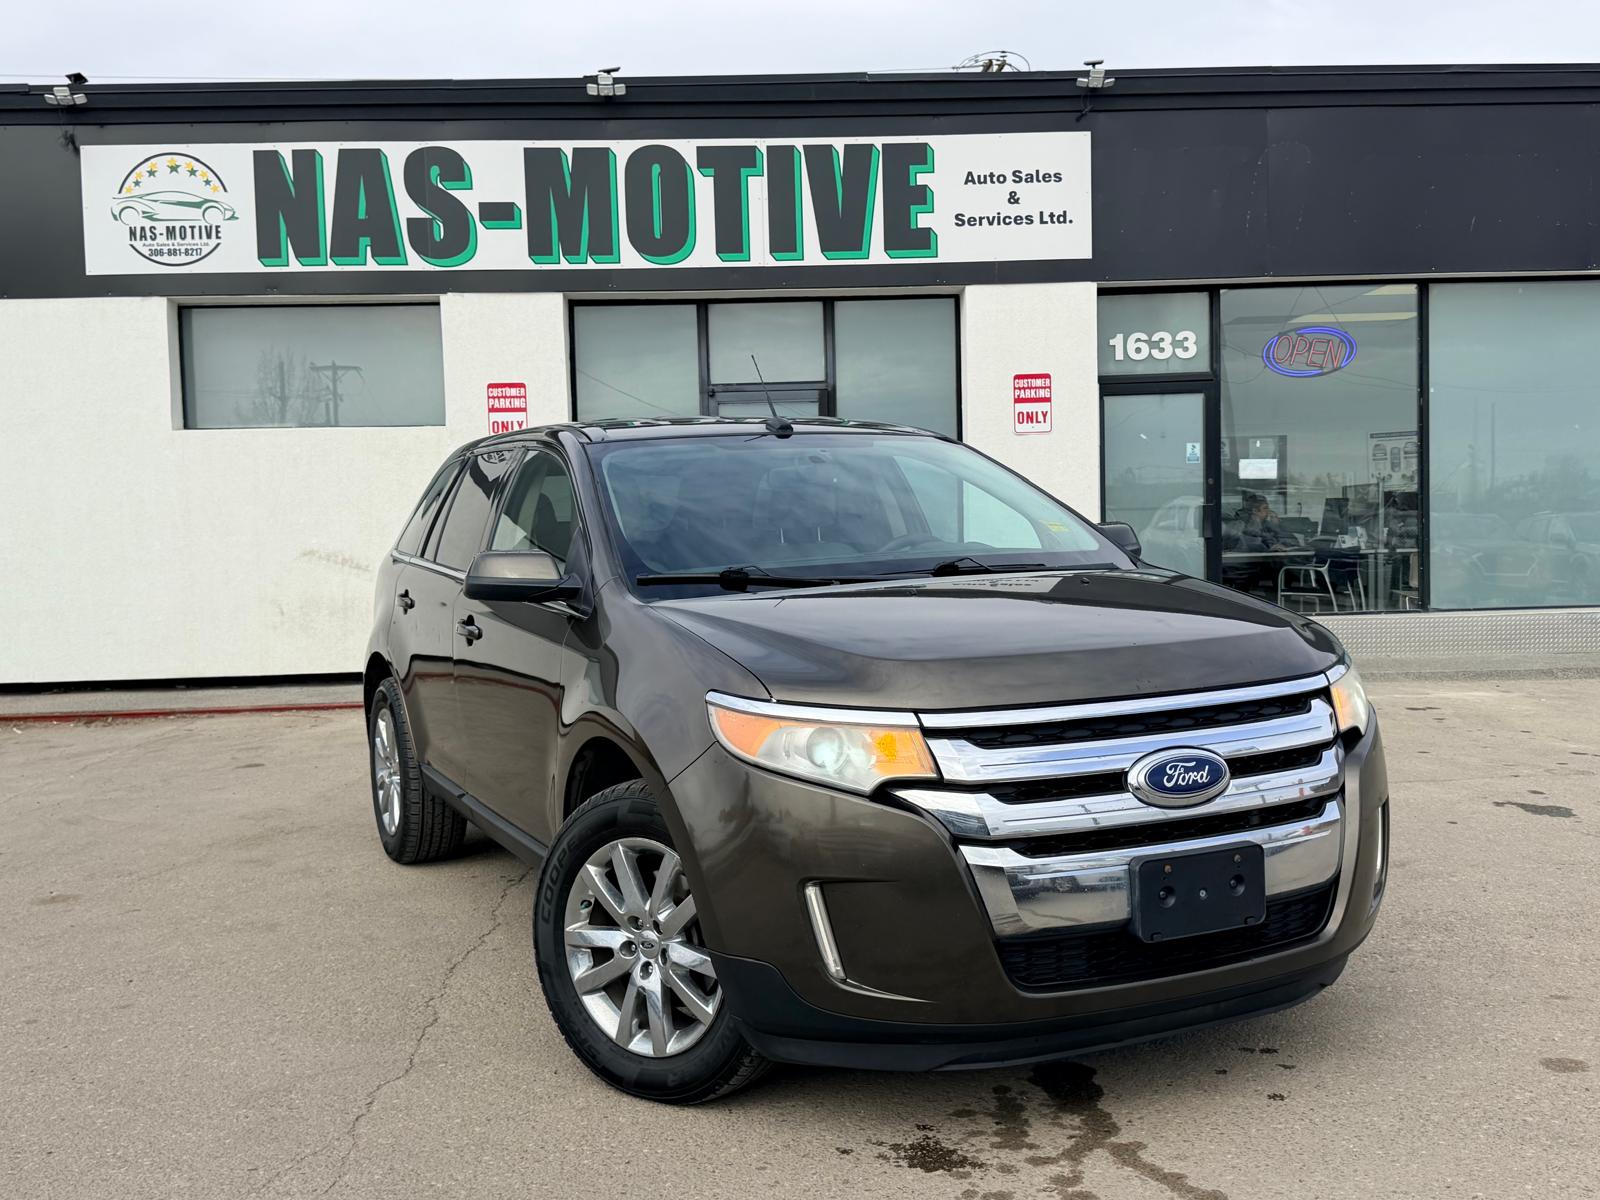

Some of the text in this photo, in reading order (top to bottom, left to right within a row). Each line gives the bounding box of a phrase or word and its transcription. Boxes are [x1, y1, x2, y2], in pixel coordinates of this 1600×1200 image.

[964, 169, 1063, 185] Auto Sales
[252, 142, 938, 268] NAS-MOTIVE
[1007, 190, 1021, 205] &
[954, 210, 1073, 227] Services Ltd.
[129, 225, 222, 242] NAS-MOTIVE
[148, 248, 202, 257] 306-881-8217
[1108, 330, 1198, 361] 1633
[1274, 335, 1344, 368] OPEN
[1014, 378, 1051, 388] CUSTOMER
[488, 387, 526, 397] CUSTOMER
[1014, 388, 1051, 399] PARKING
[488, 397, 526, 408] PARKING
[1017, 410, 1049, 424] ONLY
[1163, 761, 1210, 788] Ford
